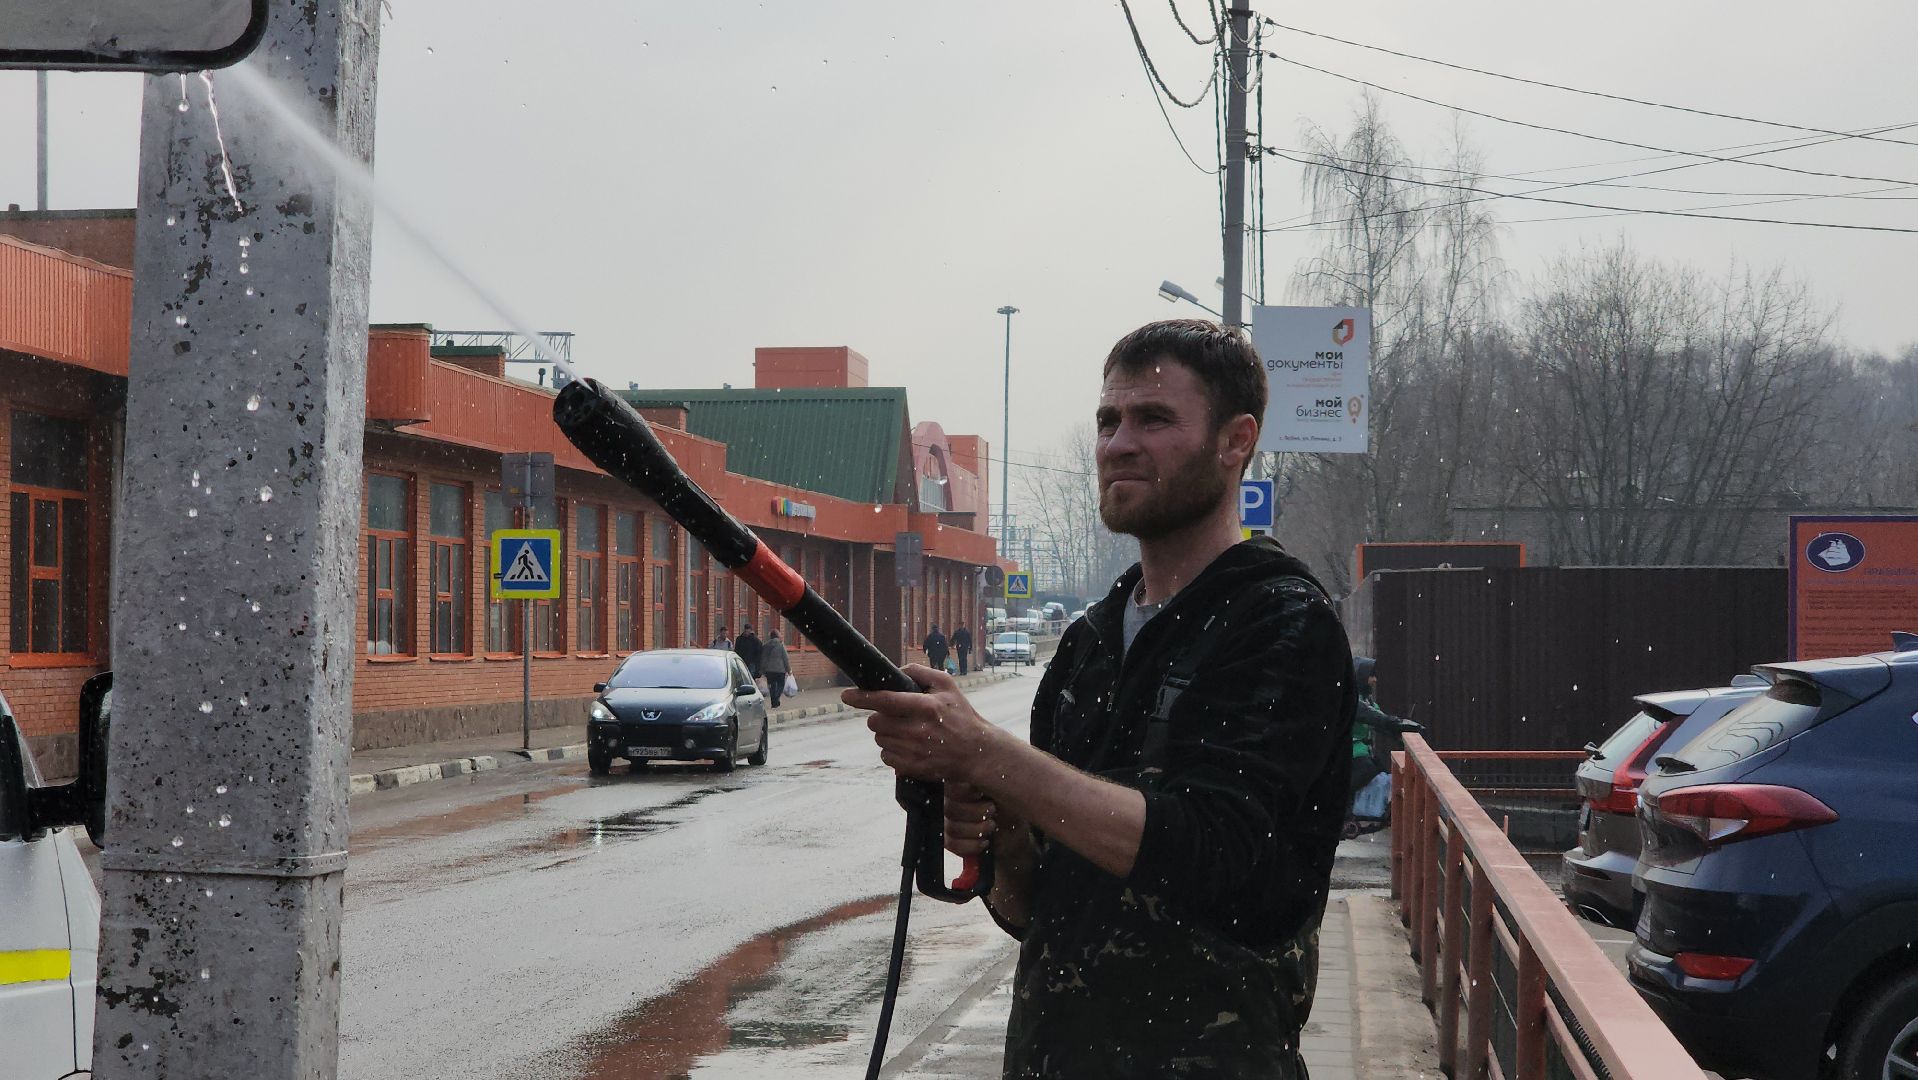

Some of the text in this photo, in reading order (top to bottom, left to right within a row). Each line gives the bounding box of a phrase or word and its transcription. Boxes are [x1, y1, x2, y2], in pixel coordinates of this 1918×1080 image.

[1315, 352, 1343, 360] мои
[1267, 359, 1343, 371] документы
[1315, 396, 1342, 408] мой
[1296, 405, 1342, 418] бизнес
[1240, 486, 1264, 520] P
